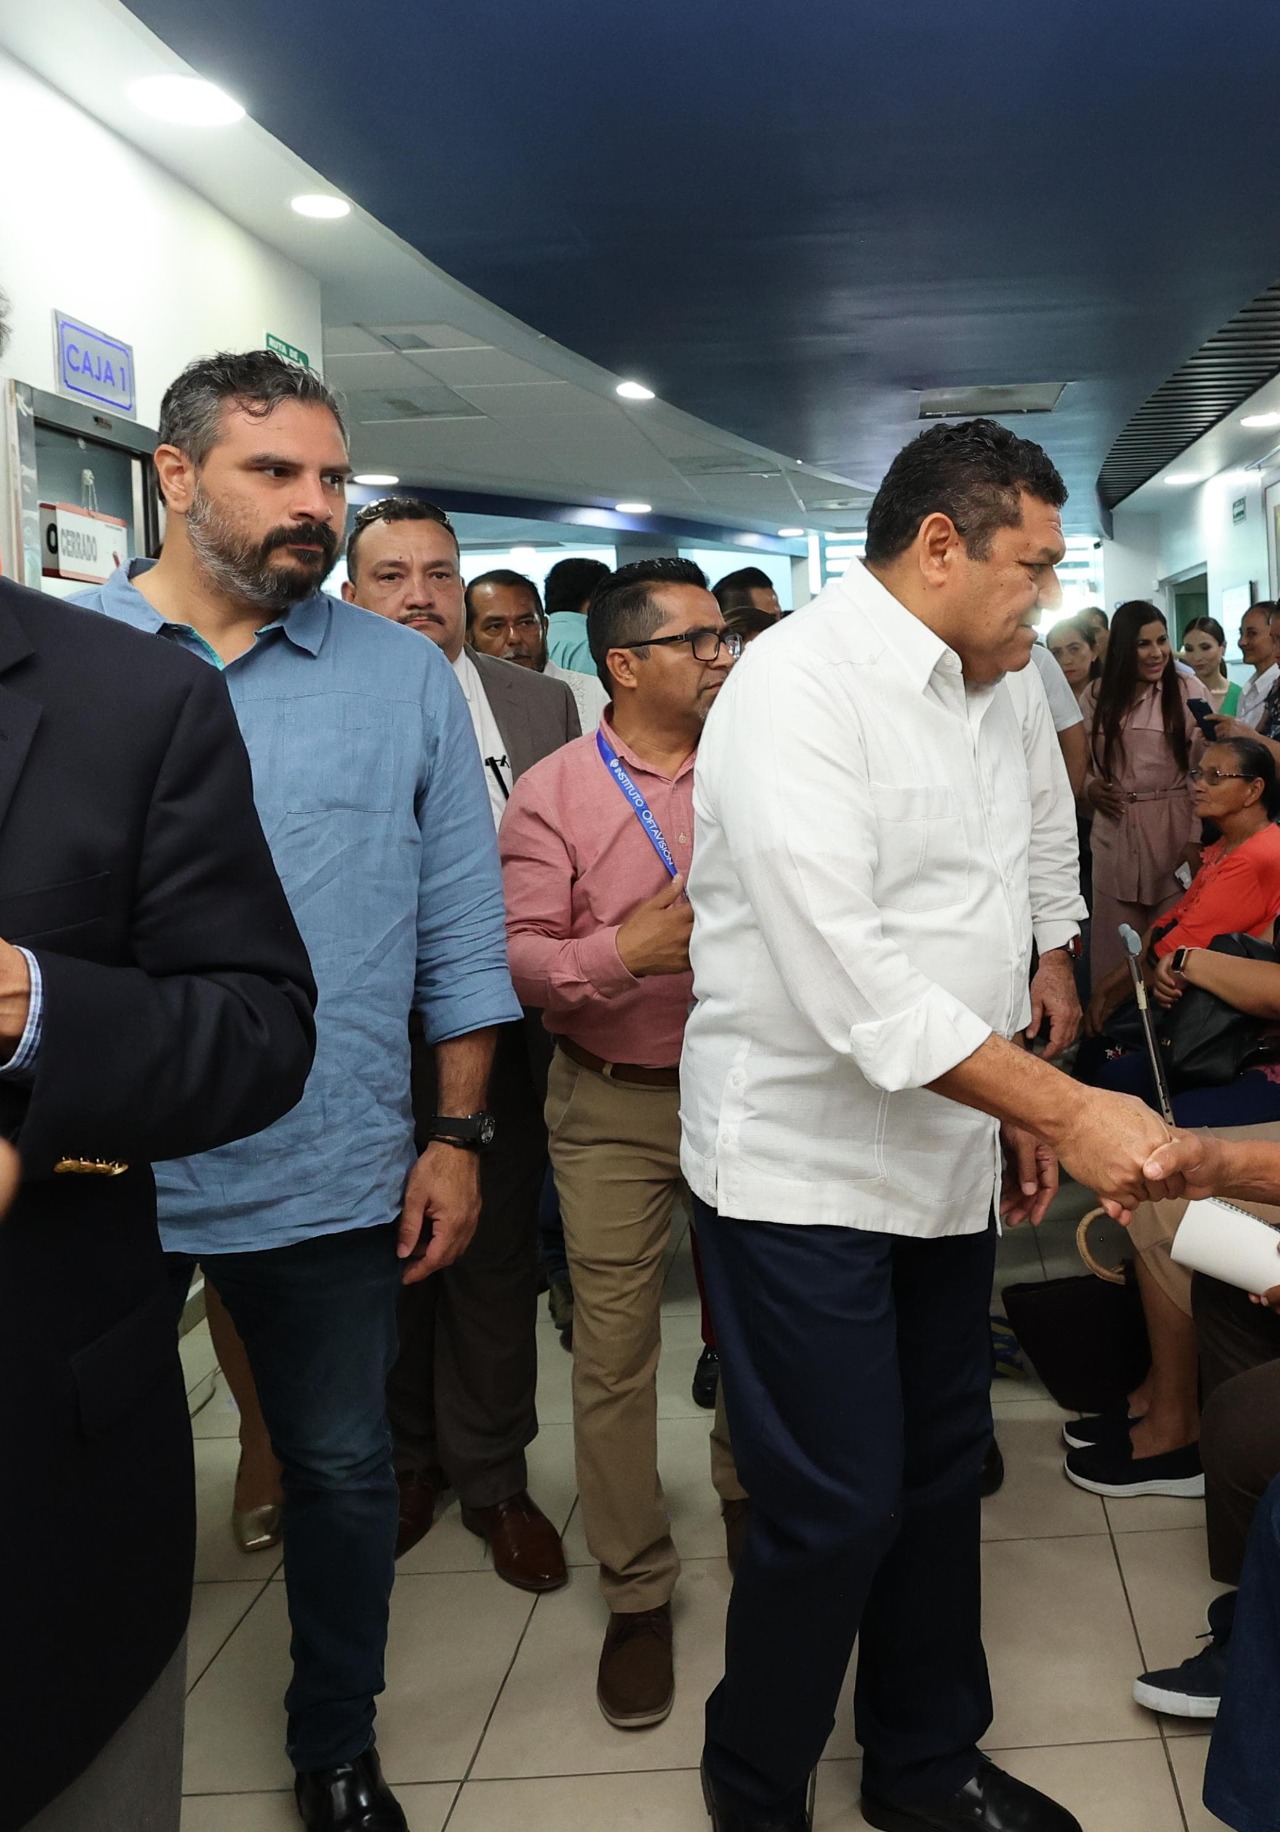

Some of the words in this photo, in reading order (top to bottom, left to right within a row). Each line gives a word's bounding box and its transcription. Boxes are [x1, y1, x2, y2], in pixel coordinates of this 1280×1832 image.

[66, 343, 115, 387] CAJA
[119, 366, 126, 392] 1
[60, 528, 98, 563] CERRADO
[614, 767, 644, 807] INSTITUTO
